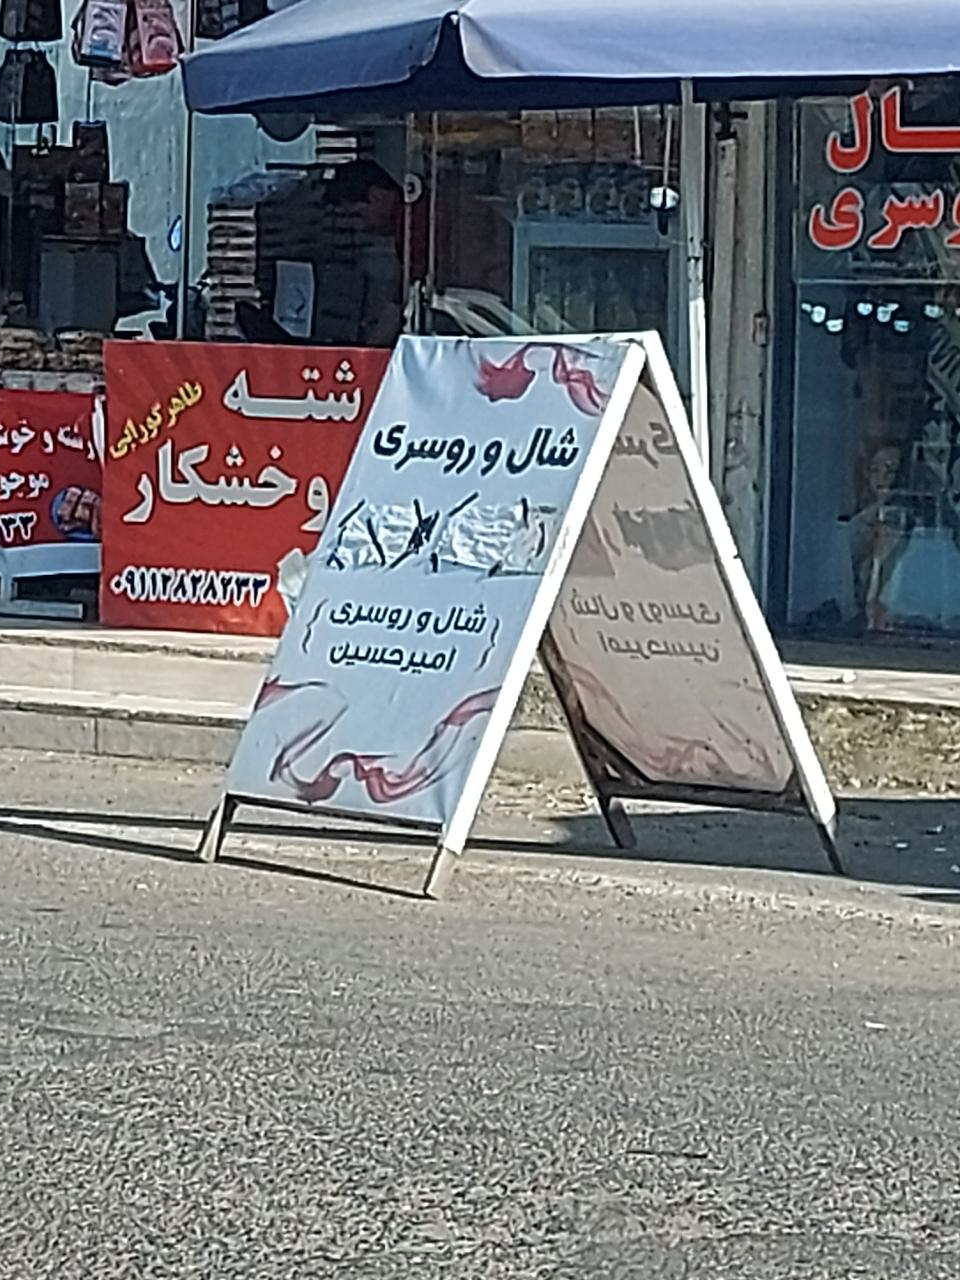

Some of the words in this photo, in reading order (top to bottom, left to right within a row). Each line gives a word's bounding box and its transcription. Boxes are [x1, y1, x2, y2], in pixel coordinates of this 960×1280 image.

[223, 360, 362, 422] شته
[373, 423, 477, 475] روسری
[479, 440, 503, 477] و
[506, 426, 580, 475] شال
[123, 439, 297, 525] خشکار
[329, 601, 413, 631] روسری
[416, 610, 433, 633] و
[433, 602, 487, 634] شال
